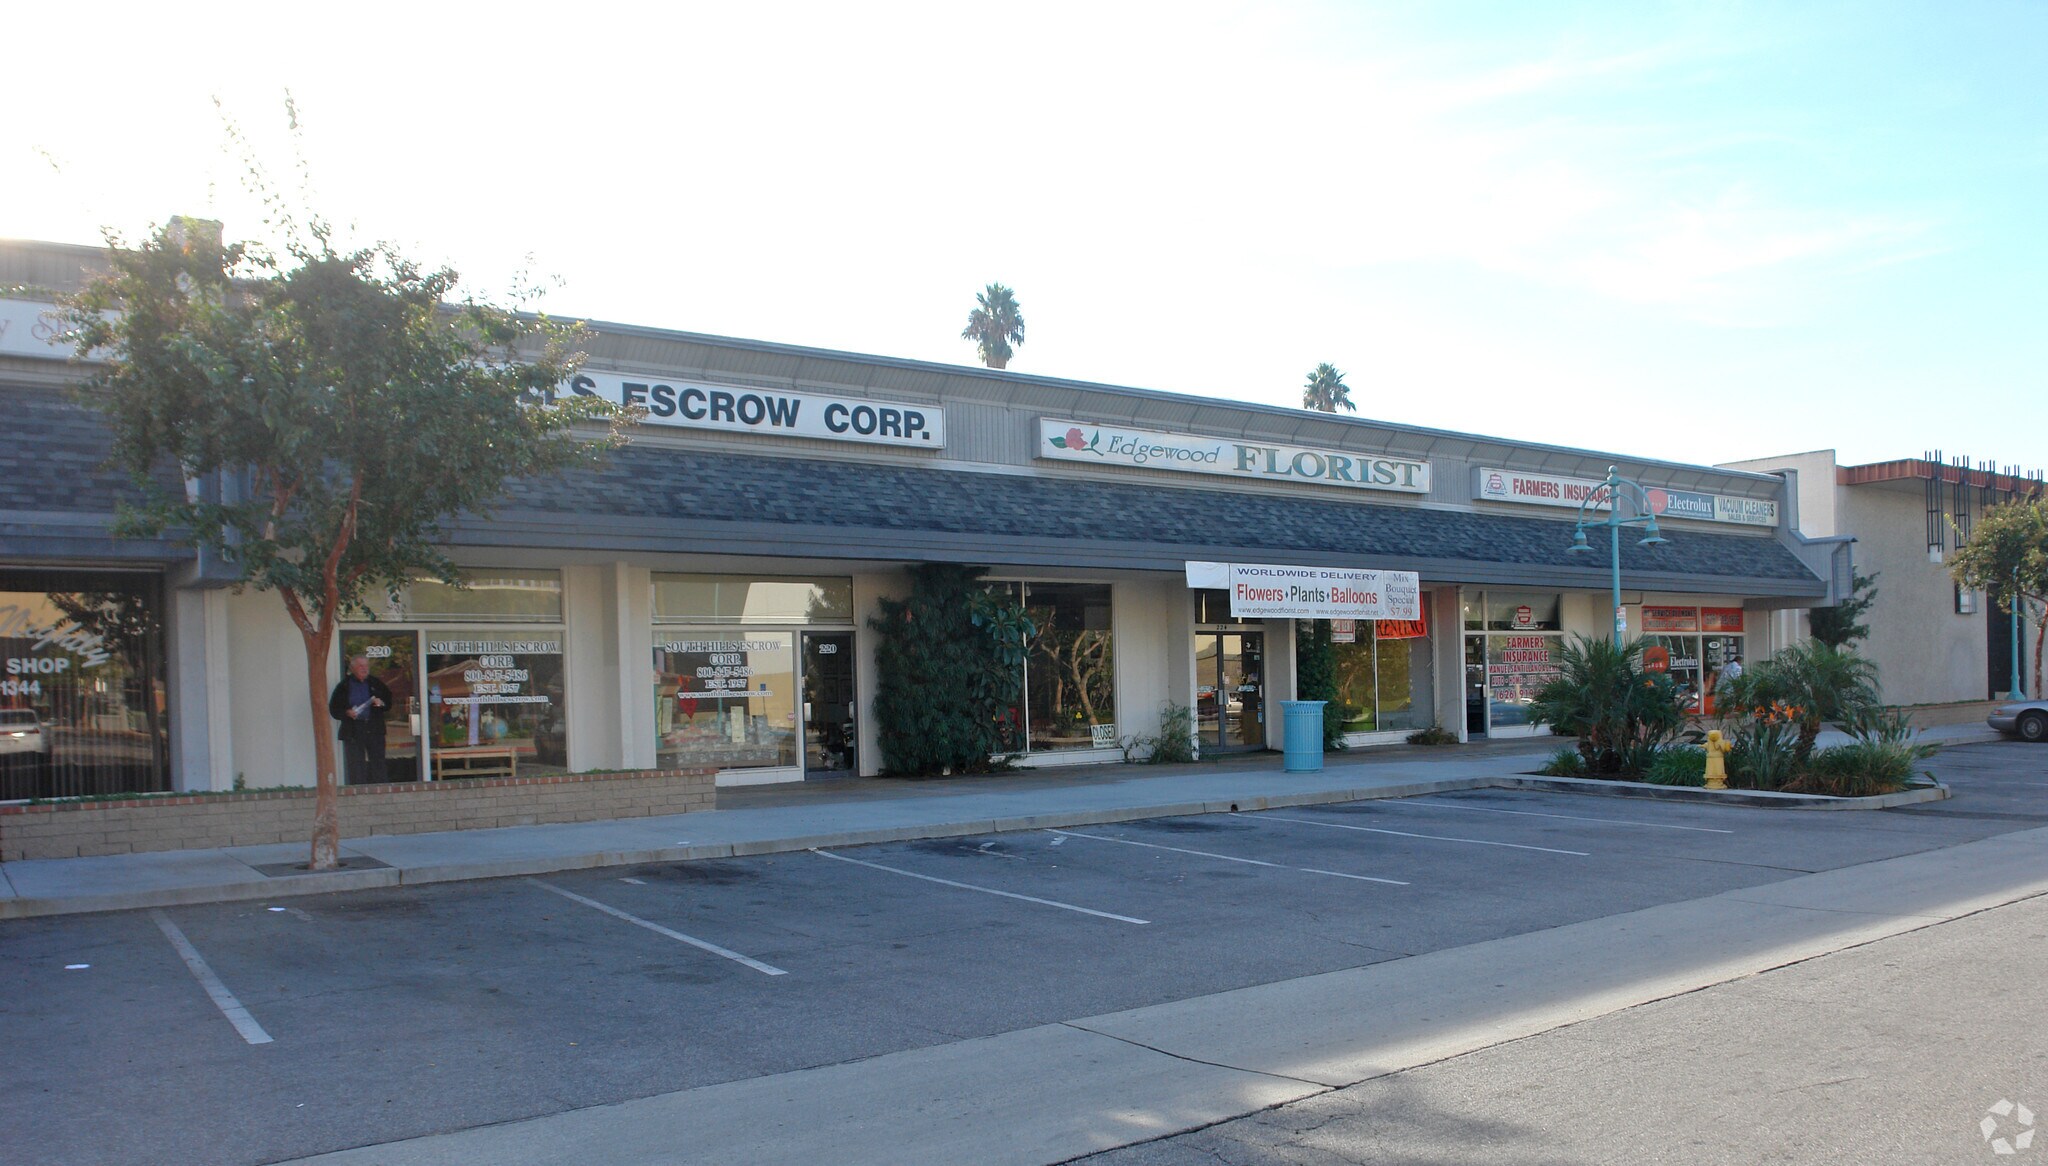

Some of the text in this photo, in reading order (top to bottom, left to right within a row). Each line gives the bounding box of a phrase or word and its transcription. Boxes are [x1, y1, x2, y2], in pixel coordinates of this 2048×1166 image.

[622, 382, 800, 427] ESCROW
[824, 403, 930, 440] CORP.
[1107, 435, 1221, 463] Edgewood
[1232, 444, 1421, 488] FLORIST
[1513, 478, 1560, 498] FARMERS
[1667, 494, 1712, 513] Electrolux
[1718, 498, 1775, 517] VACUUM CLEANERS
[1238, 567, 1377, 581] WORLDWIDE DELIVERY
[1393, 573, 1409, 582] Mix
[1237, 583, 1377, 604] Flowers Plants Balloons
[1385, 583, 1417, 596] Bouquet
[1388, 594, 1415, 606] Special
[429, 640, 560, 653] SOUTH HILLS ESCROW
[665, 640, 781, 652] SOUTH HILLS ESCROW
[819, 643, 838, 654] 220
[1506, 636, 1545, 649] FARMERS
[366, 645, 391, 658] 220
[1503, 650, 1549, 663] INSURANCE
[7, 657, 70, 673] SHOP
[479, 655, 515, 668] CORP.
[709, 654, 741, 666] CORP.
[1670, 655, 1698, 666] Electrolux
[697, 667, 754, 678] 800-847-5486
[1489, 664, 1510, 673] MANUEL
[464, 669, 528, 682] 800-847-5486
[1491, 676, 1505, 686] AUTO
[1508, 675, 1523, 686] HOME
[474, 683, 519, 694] EST. 1957
[705, 679, 747, 689] EST. 1957
[443, 695, 549, 705] www.southhillsescrow.com
[677, 690, 773, 699] www.southhillsescrow.com
[1496, 688, 1518, 701] (626)
[1092, 725, 1115, 740] CLOSED
